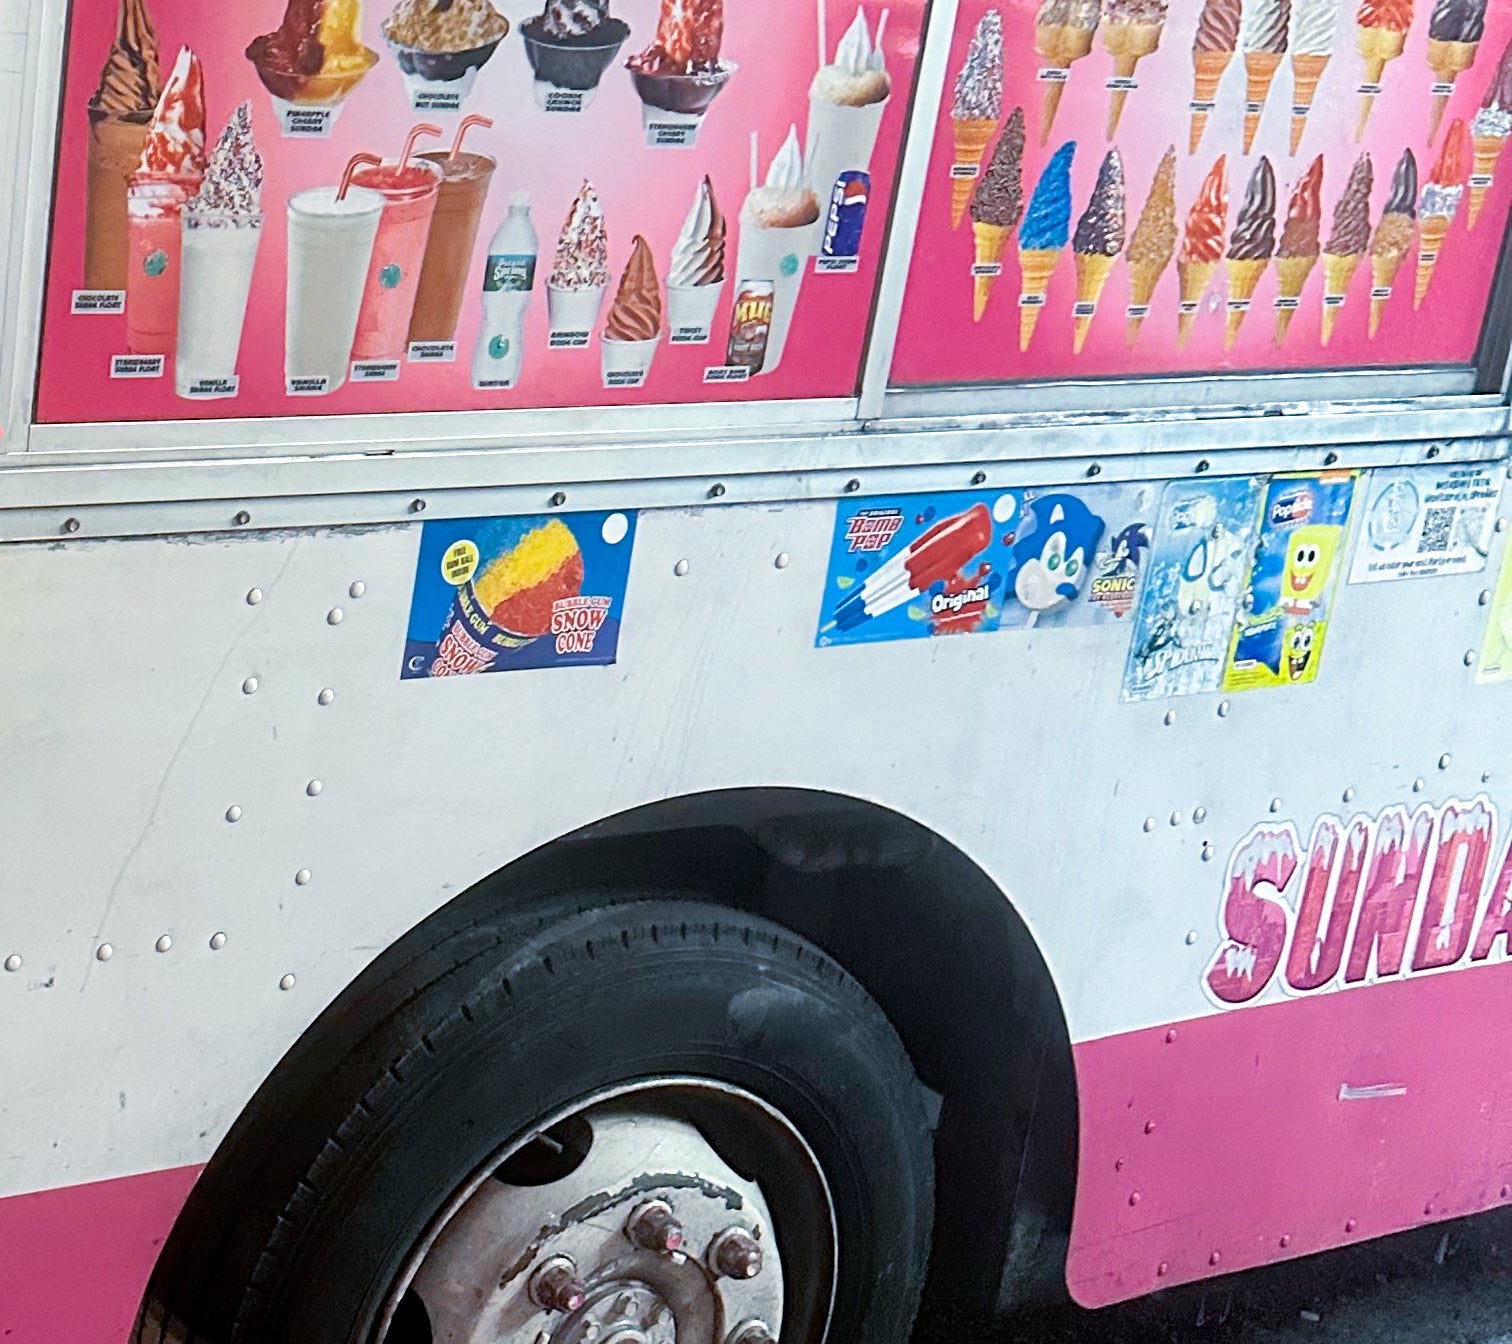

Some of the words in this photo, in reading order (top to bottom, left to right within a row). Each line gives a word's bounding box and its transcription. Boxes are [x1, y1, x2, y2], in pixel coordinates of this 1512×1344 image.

[823, 180, 846, 255] PEPSI
[494, 264, 527, 280] Spring
[98, 301, 122, 309] FLOAT
[213, 385, 236, 393] FLOAT
[291, 378, 327, 386] VANILLA
[849, 517, 903, 534] BOMB
[849, 533, 891, 551] POP
[1092, 576, 1136, 593] SONIC
[931, 583, 989, 614] Original
[553, 609, 607, 633] SNOW
[557, 631, 595, 653] CONE
[439, 634, 483, 674] SNOW
